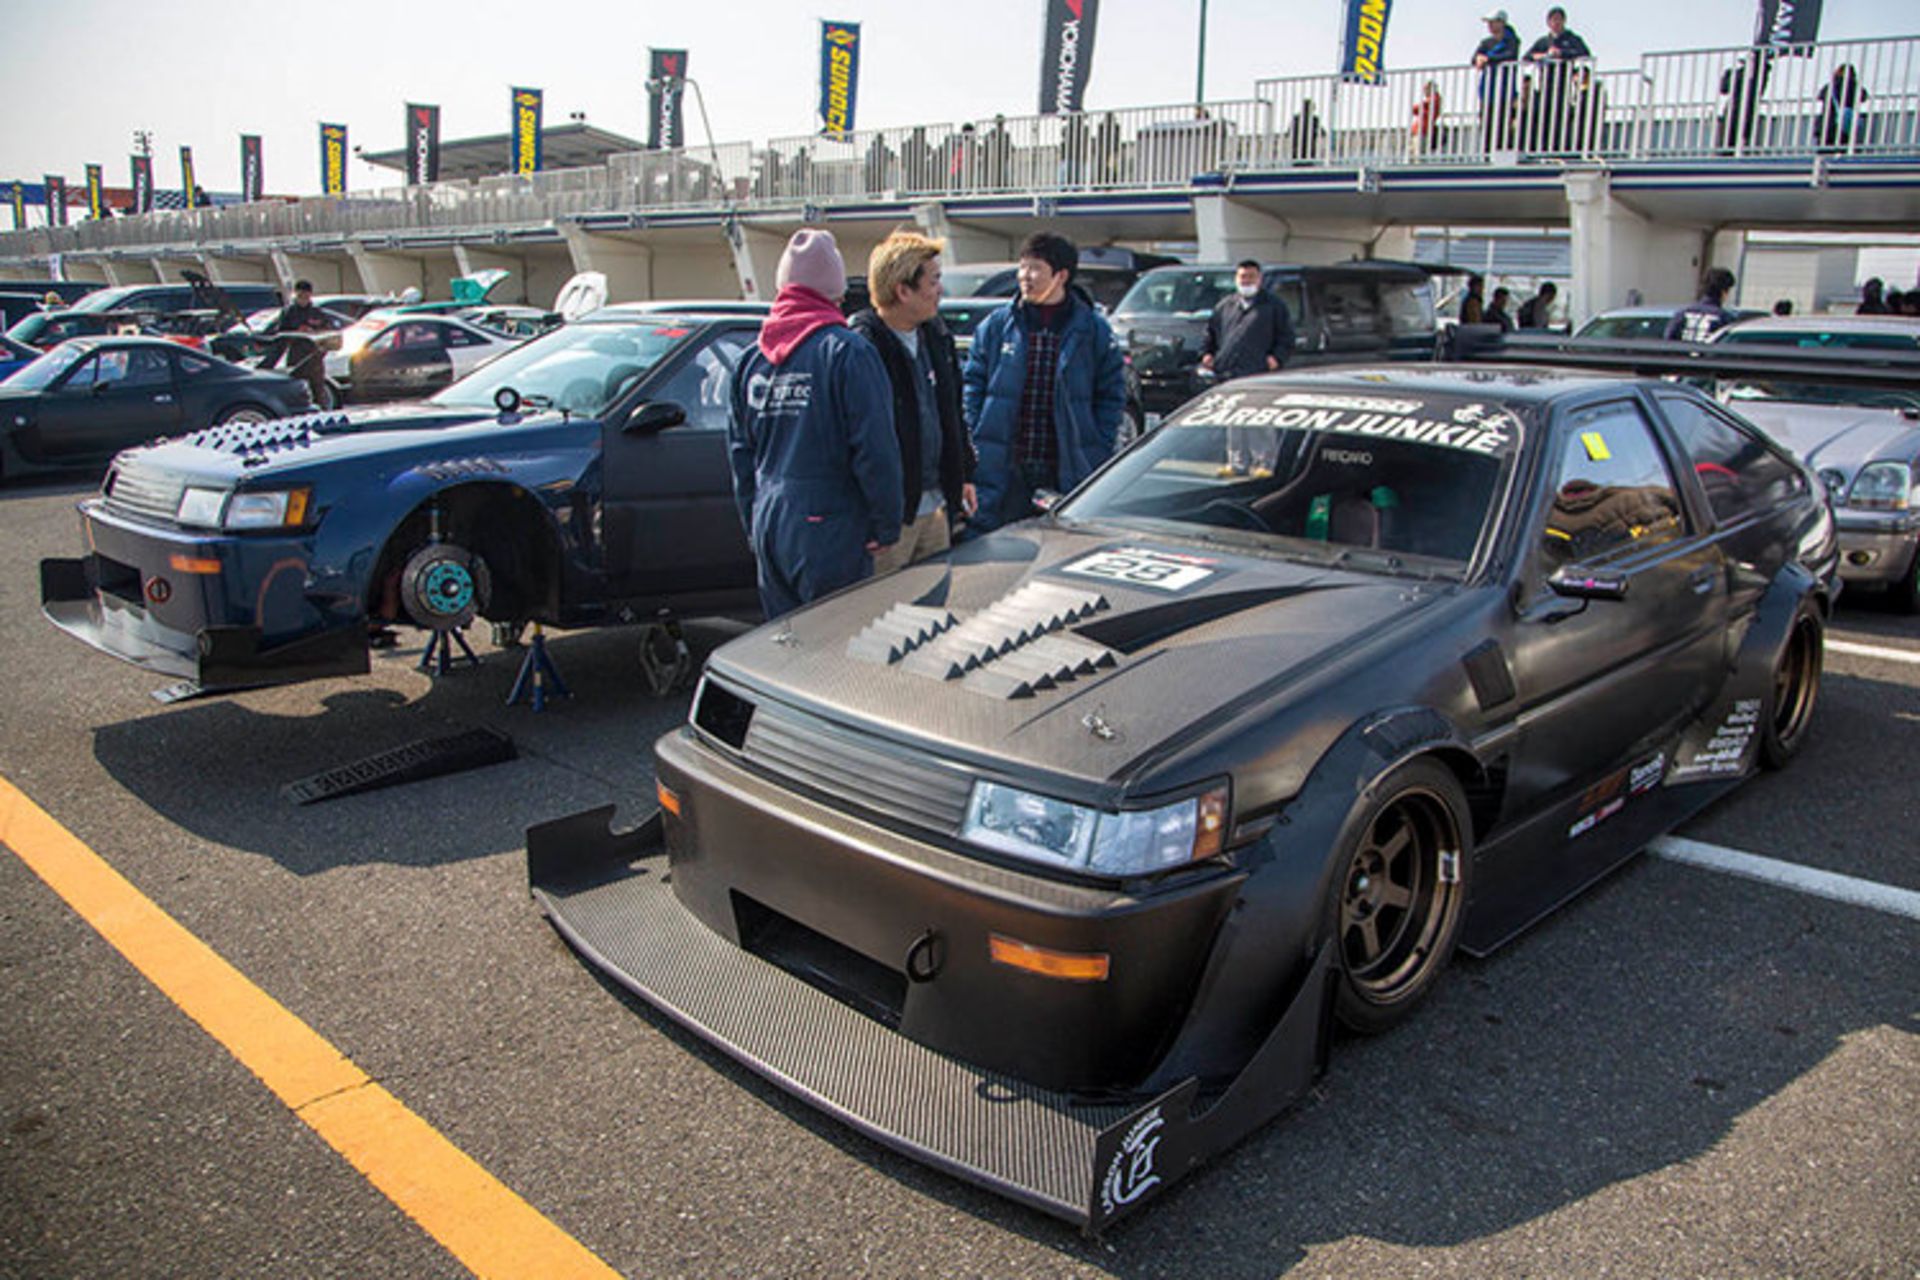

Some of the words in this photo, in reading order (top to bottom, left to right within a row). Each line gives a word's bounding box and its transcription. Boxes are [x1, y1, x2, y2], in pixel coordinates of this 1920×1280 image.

[1056, 19, 1080, 117] YOKOHAMA
[1180, 407, 1344, 429] CARBON
[1336, 412, 1510, 453] JUNKIE
